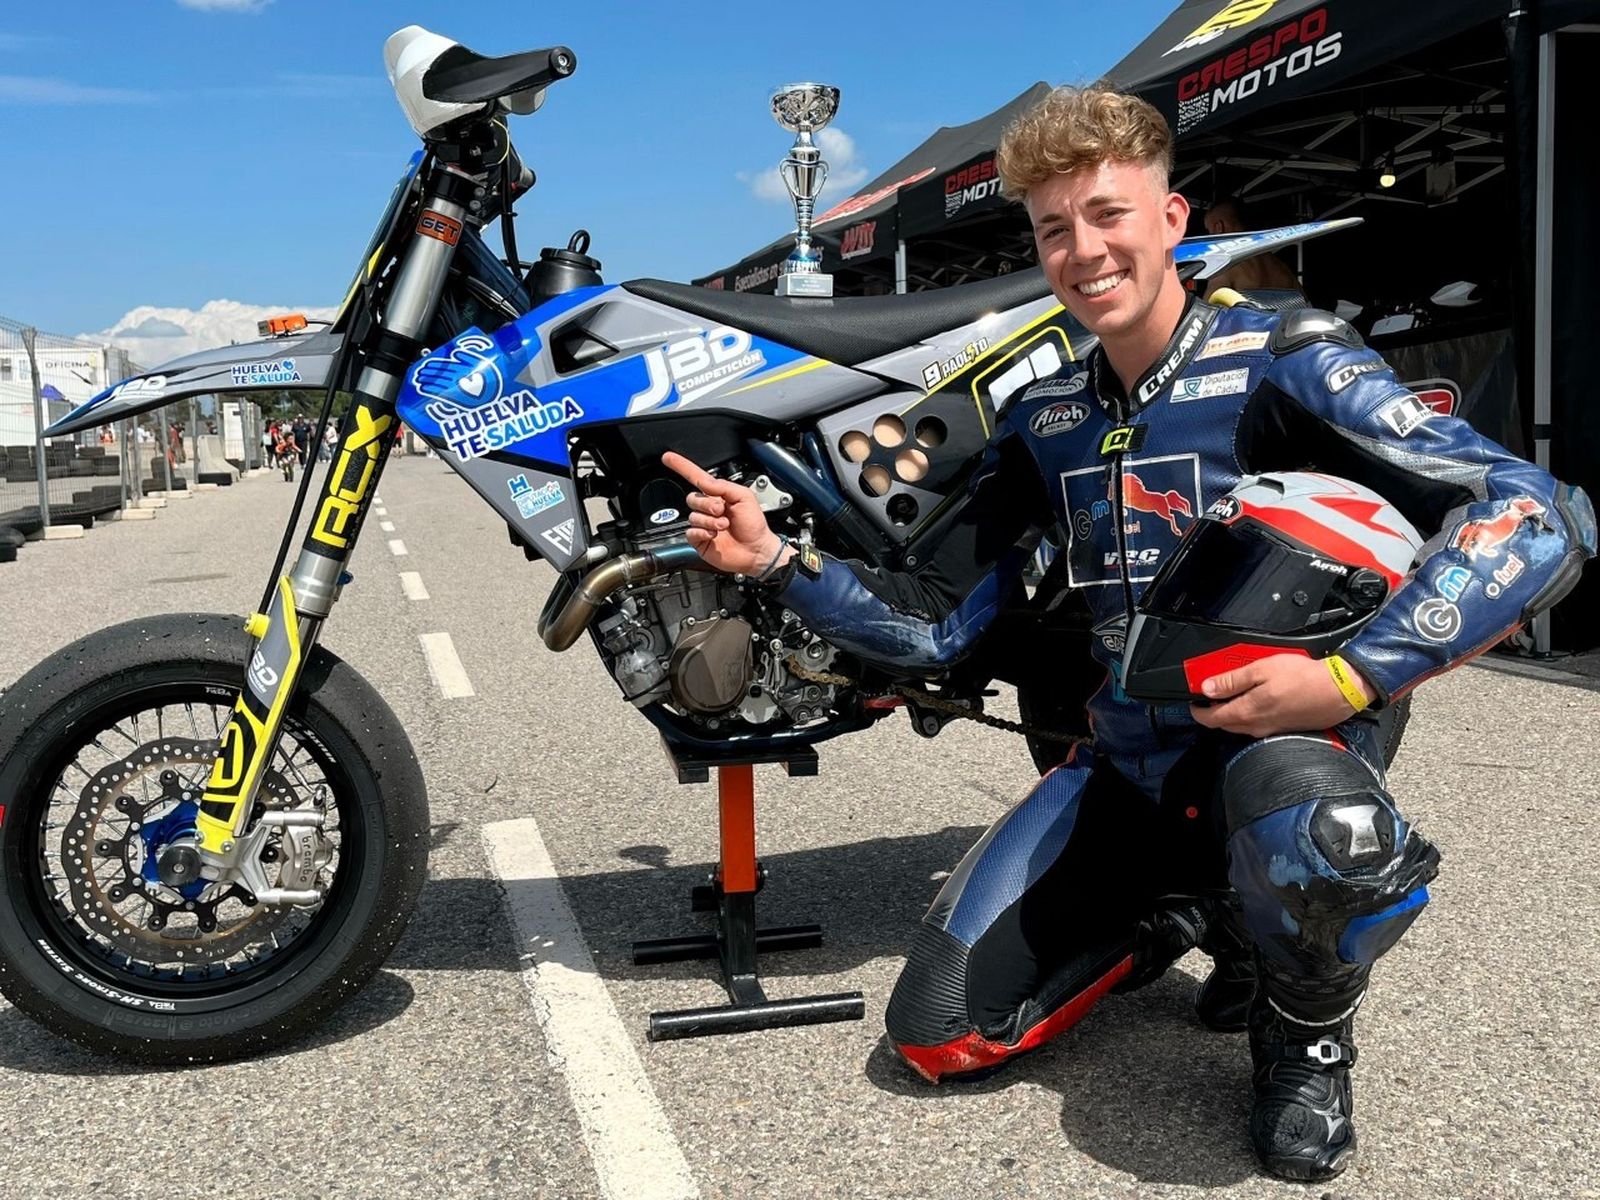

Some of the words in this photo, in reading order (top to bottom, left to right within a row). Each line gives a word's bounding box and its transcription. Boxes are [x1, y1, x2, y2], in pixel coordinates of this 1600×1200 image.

[1211, 32, 1342, 112] MOTOS
[422, 217, 457, 238] GET
[45, 361, 90, 369] OFICINA
[232, 363, 281, 375] HUELVA
[628, 326, 751, 417] JBD
[677, 351, 763, 393] COMPETICIÓN
[923, 362, 941, 389] 9
[1138, 316, 1204, 403] CREAM
[233, 375, 248, 385] TE
[250, 372, 301, 384] SALUDA
[443, 392, 539, 441] HUELVA
[451, 433, 486, 459] TE
[486, 398, 582, 447] SALUDA
[1034, 405, 1083, 430] Airoh
[1310, 559, 1348, 574] Airoh
[301, 835, 312, 882] brembo
